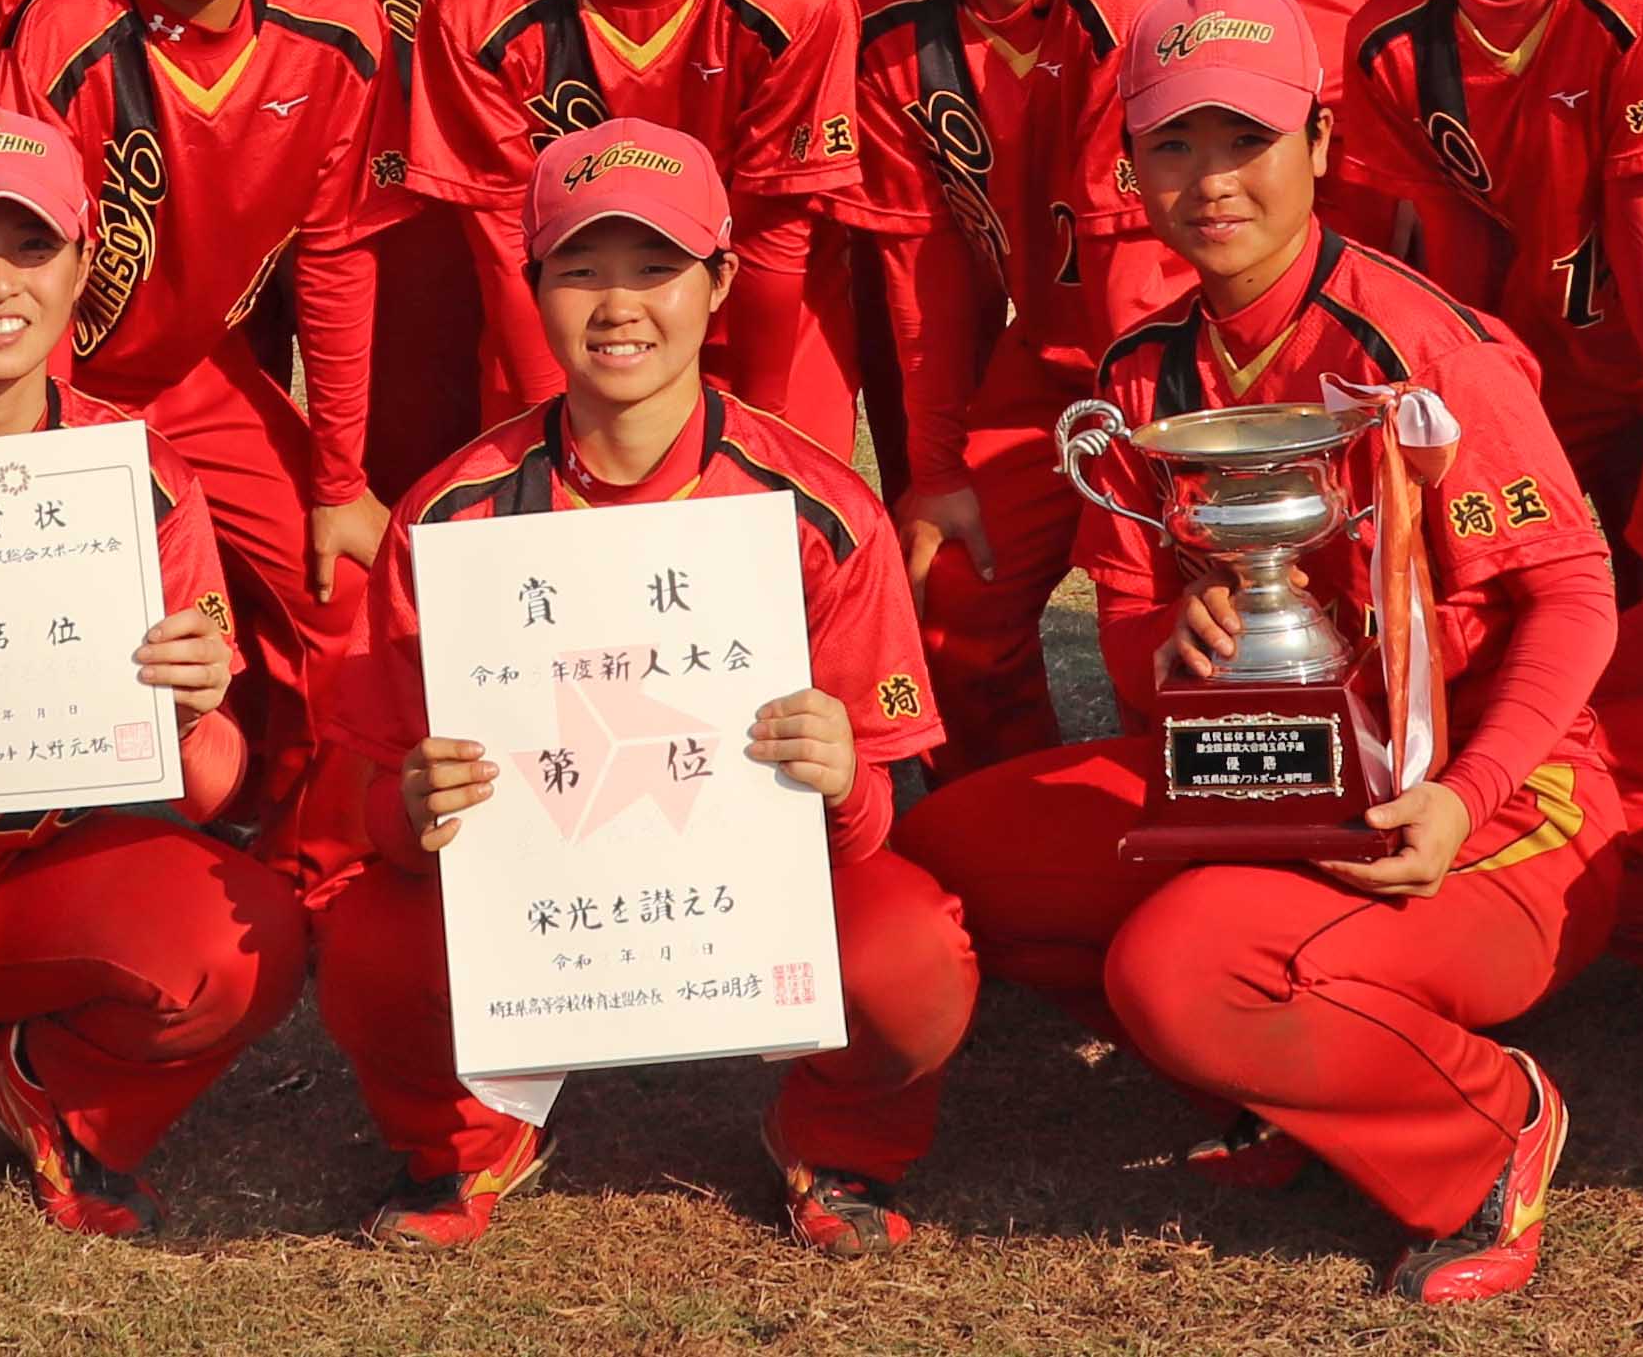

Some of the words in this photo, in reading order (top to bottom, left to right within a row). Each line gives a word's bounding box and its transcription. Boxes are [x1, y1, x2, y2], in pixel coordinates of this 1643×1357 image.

[1155, 10, 1275, 67] HOSHINO
[561, 141, 686, 194] HOSHINO
[1450, 475, 1552, 540] 埼玉
